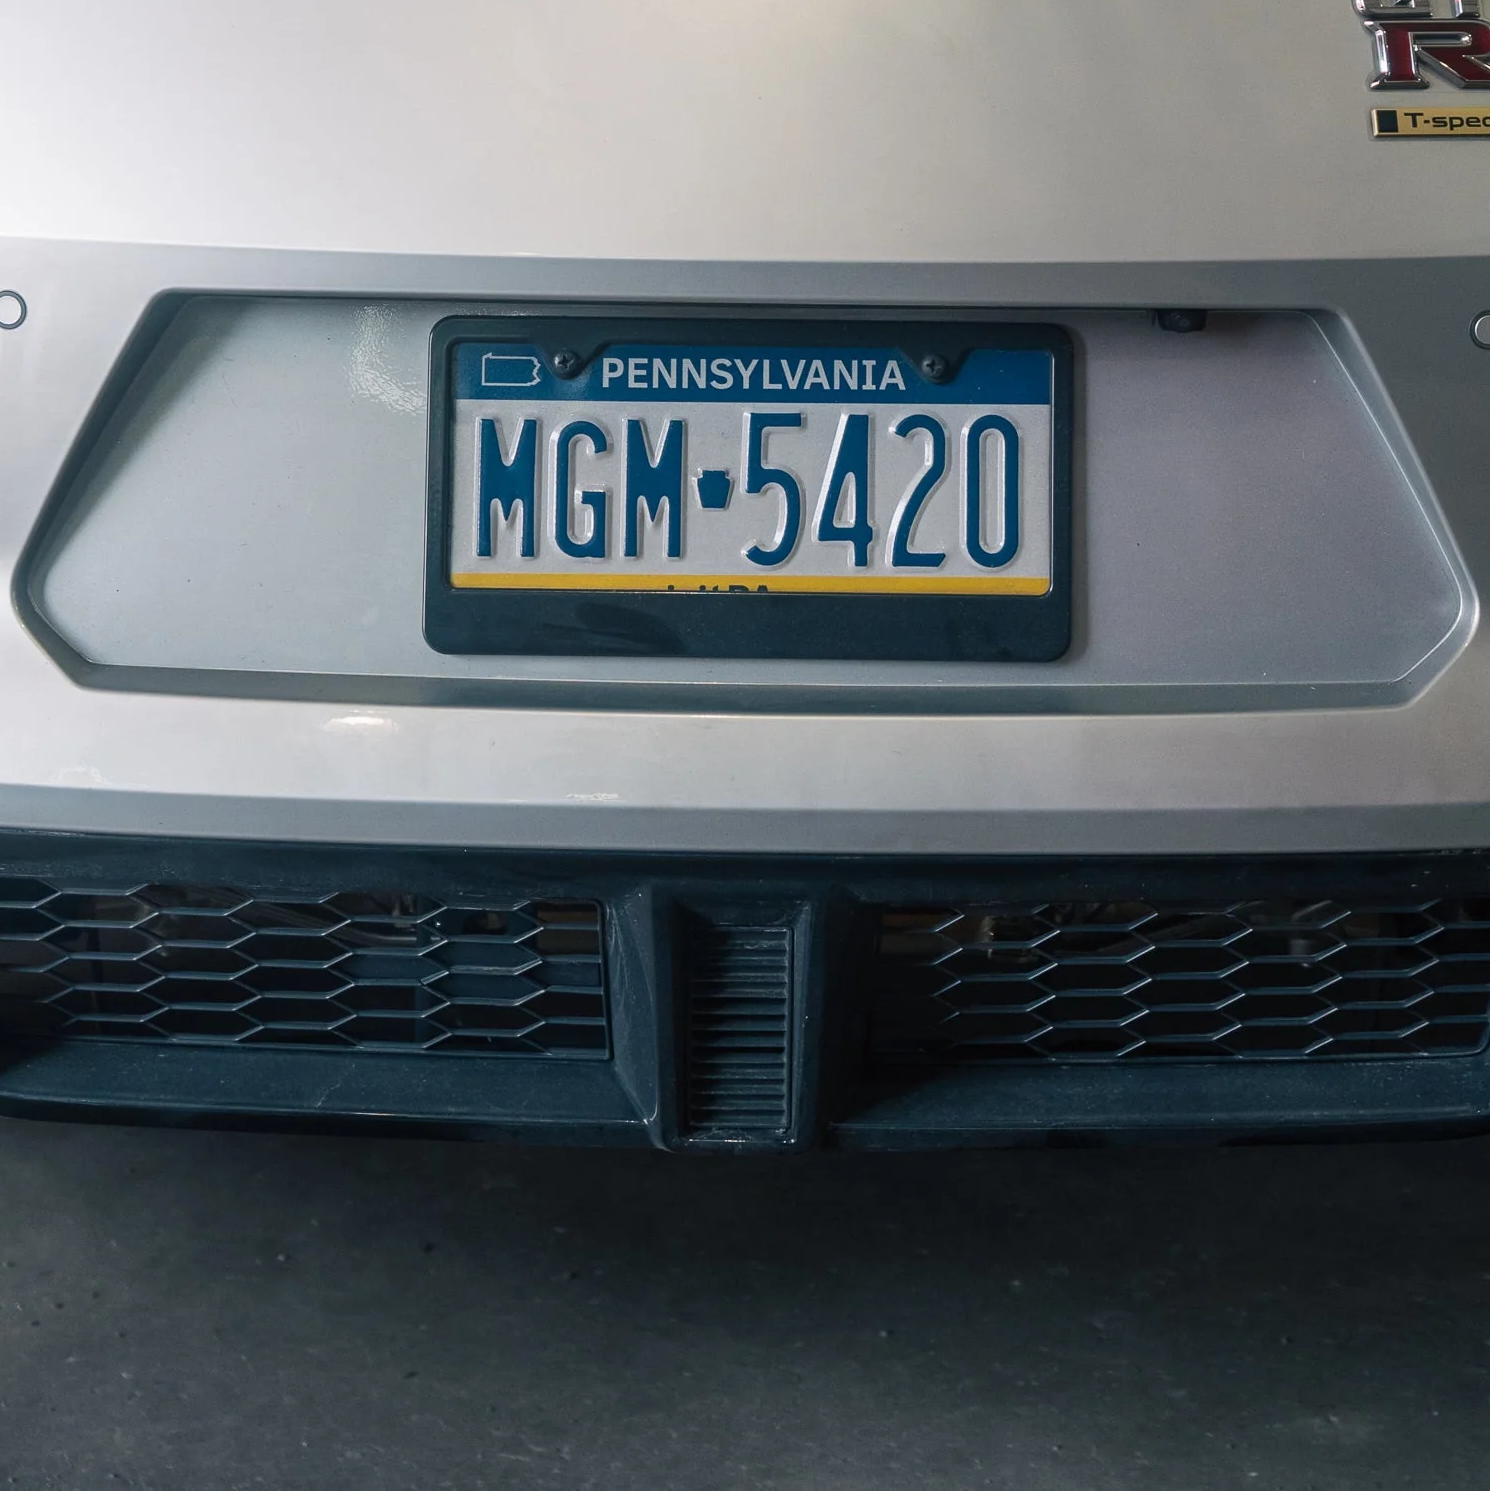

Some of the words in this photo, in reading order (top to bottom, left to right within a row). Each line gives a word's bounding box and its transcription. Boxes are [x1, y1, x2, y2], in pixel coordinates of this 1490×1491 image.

[601, 356, 907, 392] PENNSYLVANIA
[475, 417, 684, 559] MGM
[741, 411, 1020, 570] 5420
